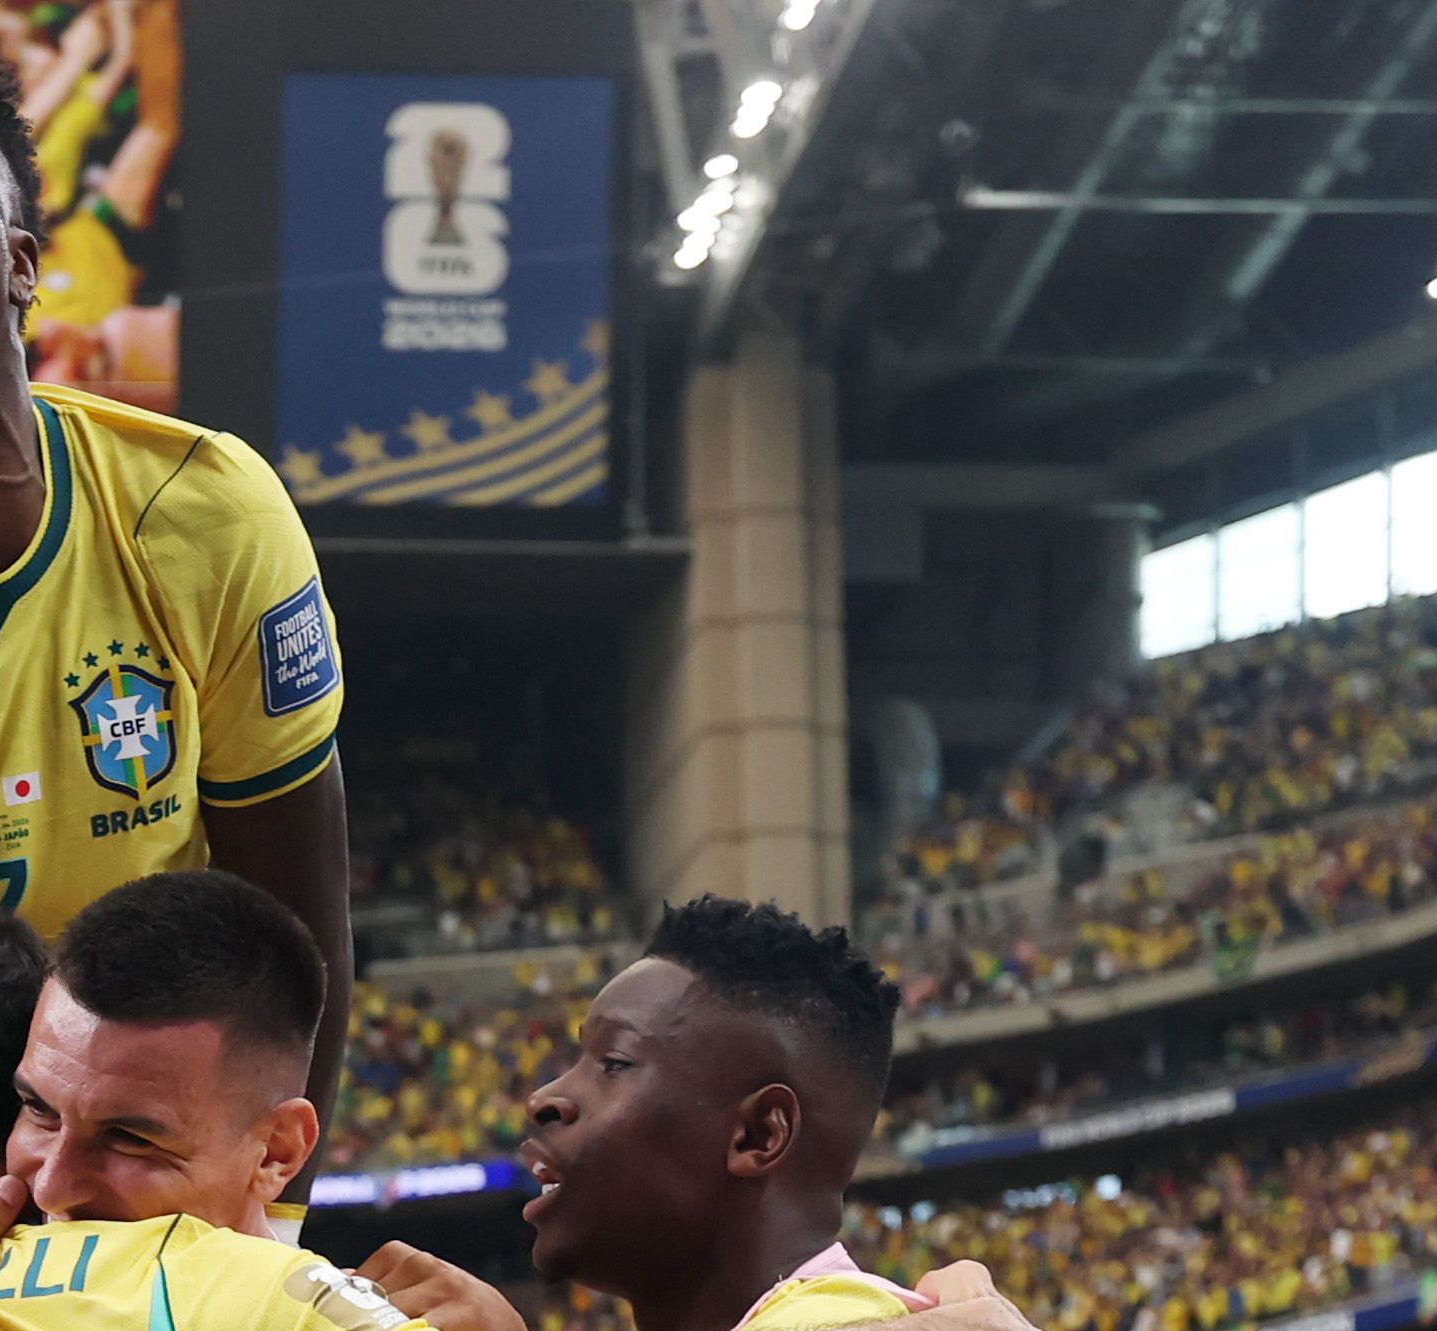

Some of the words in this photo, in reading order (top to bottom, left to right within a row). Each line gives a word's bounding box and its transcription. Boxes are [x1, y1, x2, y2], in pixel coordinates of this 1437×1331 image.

[382, 318, 507, 351] 2026
[275, 600, 318, 640] FOOTBALL
[277, 617, 322, 661] UNITES
[295, 672, 319, 689] FIFA
[110, 718, 147, 738] CBF
[91, 795, 182, 838] BRASIL
